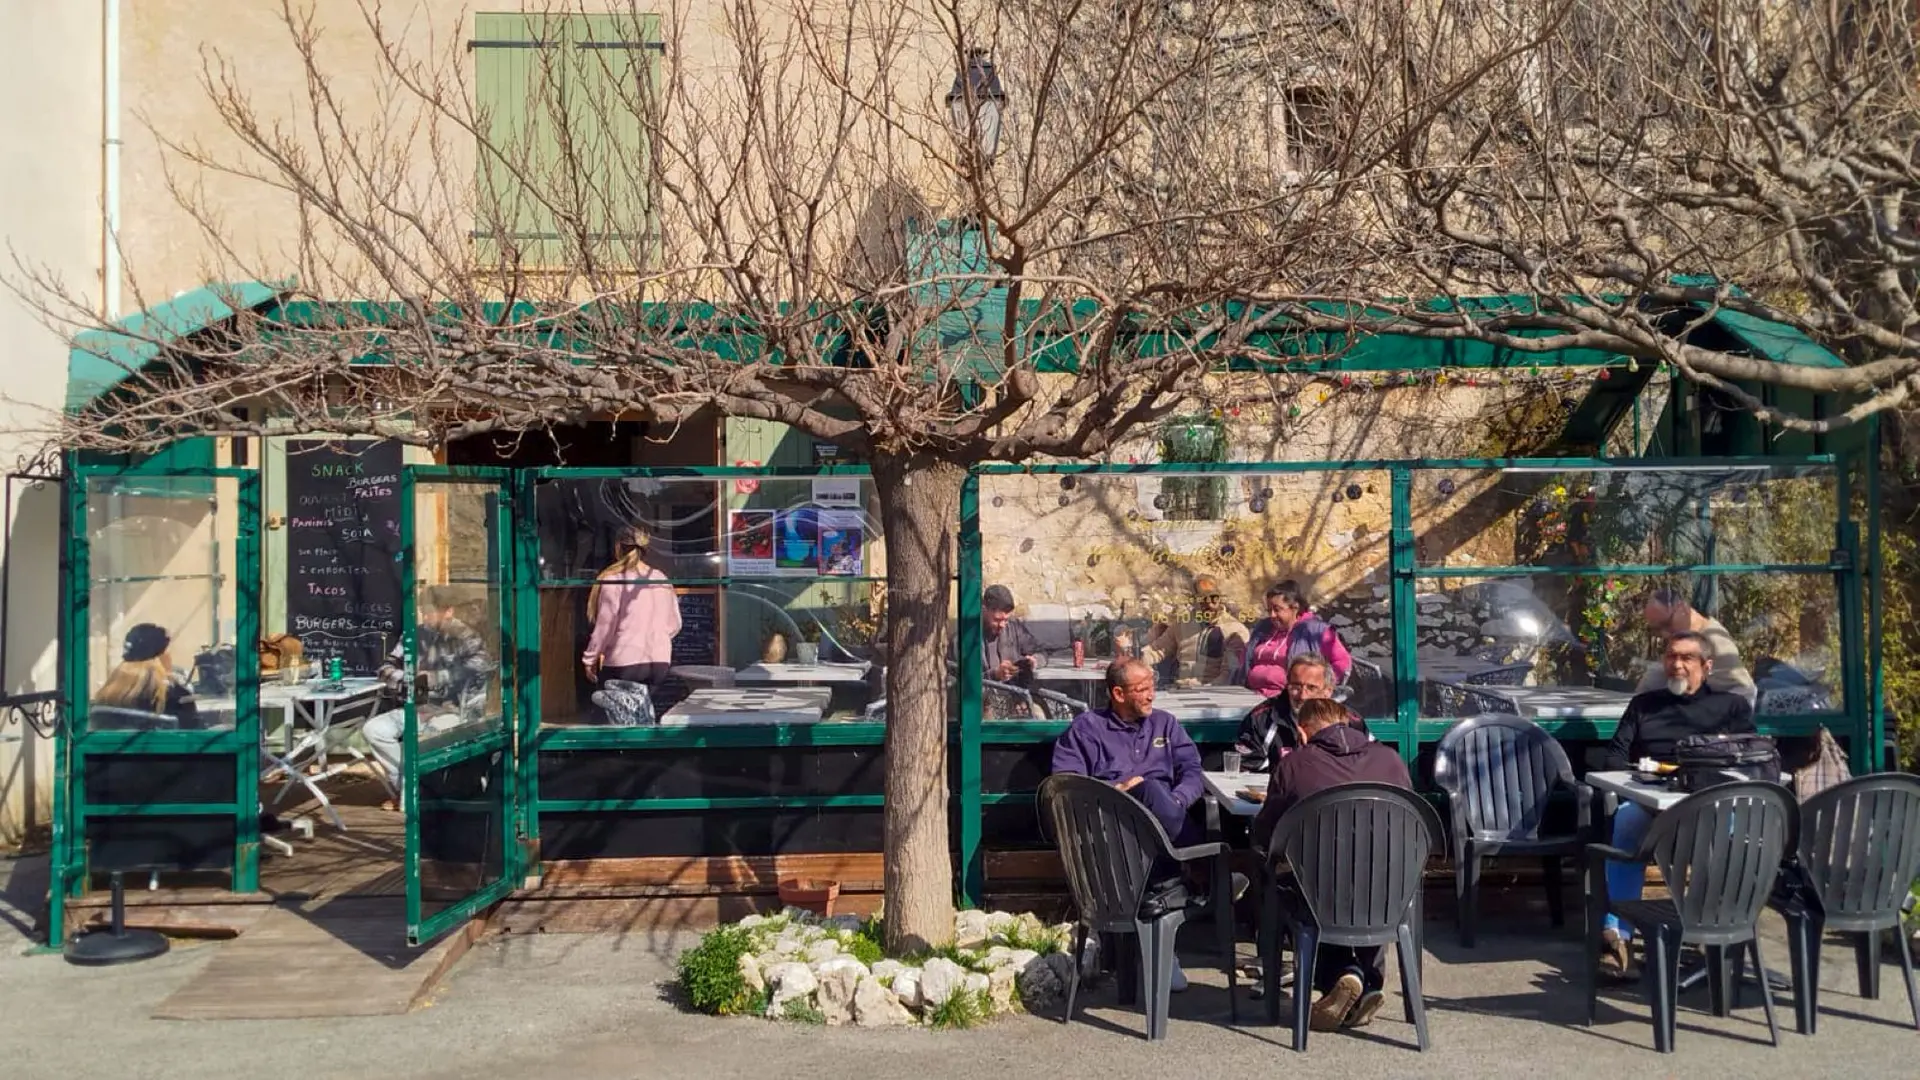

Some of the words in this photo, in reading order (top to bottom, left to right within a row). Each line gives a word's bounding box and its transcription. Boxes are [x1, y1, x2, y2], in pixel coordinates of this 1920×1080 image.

[312, 463, 364, 477] SNACK
[300, 493, 346, 505] OUVT
[308, 582, 346, 595] TACOS
[295, 614, 354, 630] BURGERS
